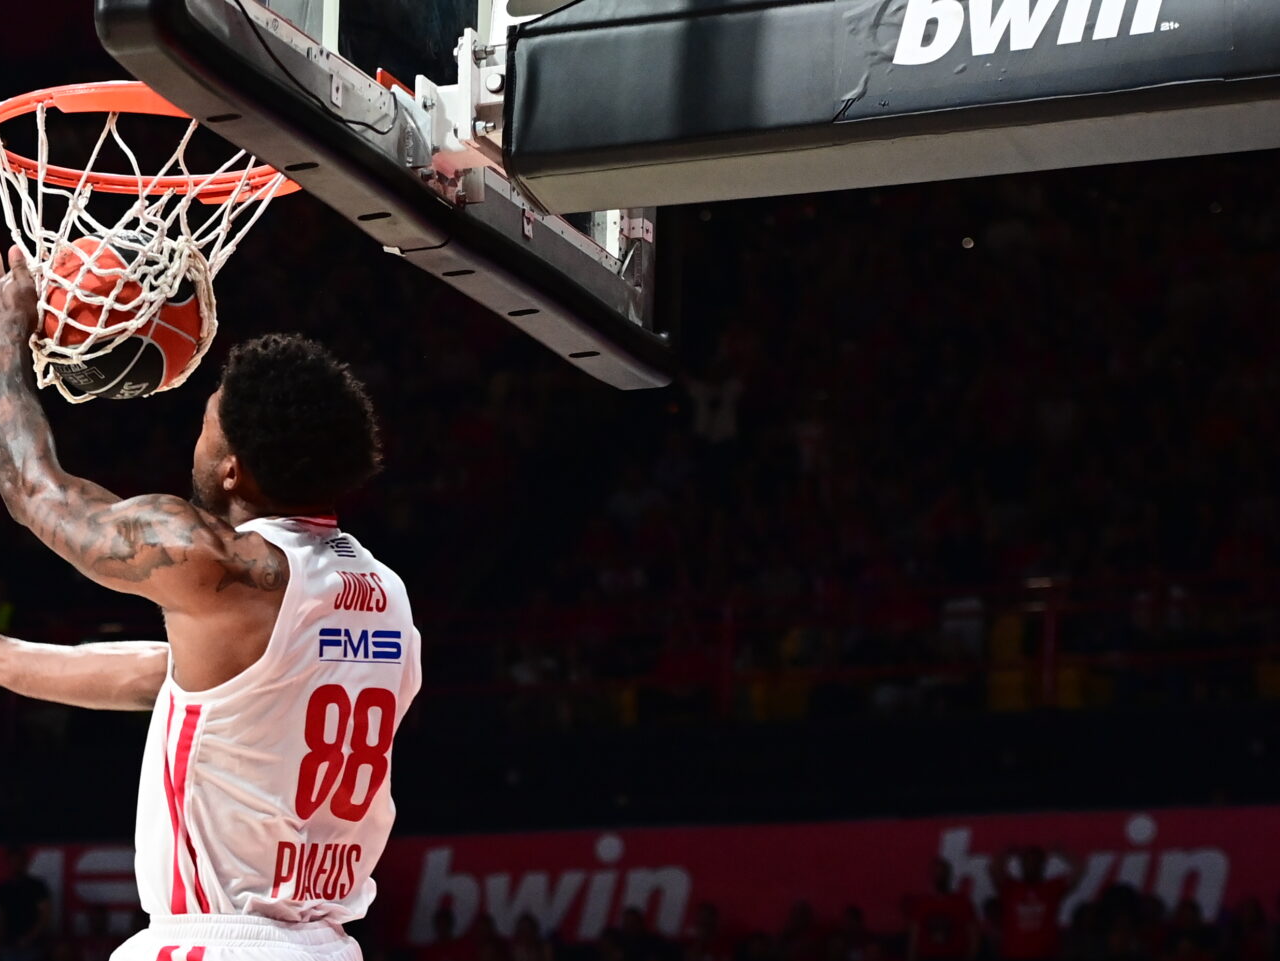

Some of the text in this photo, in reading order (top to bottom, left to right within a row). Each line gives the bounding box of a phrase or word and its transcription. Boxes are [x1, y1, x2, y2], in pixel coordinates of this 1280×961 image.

[333, 570, 388, 613] JONES
[318, 628, 402, 660] FMS
[294, 684, 398, 823] 88
[406, 832, 694, 946] bwin
